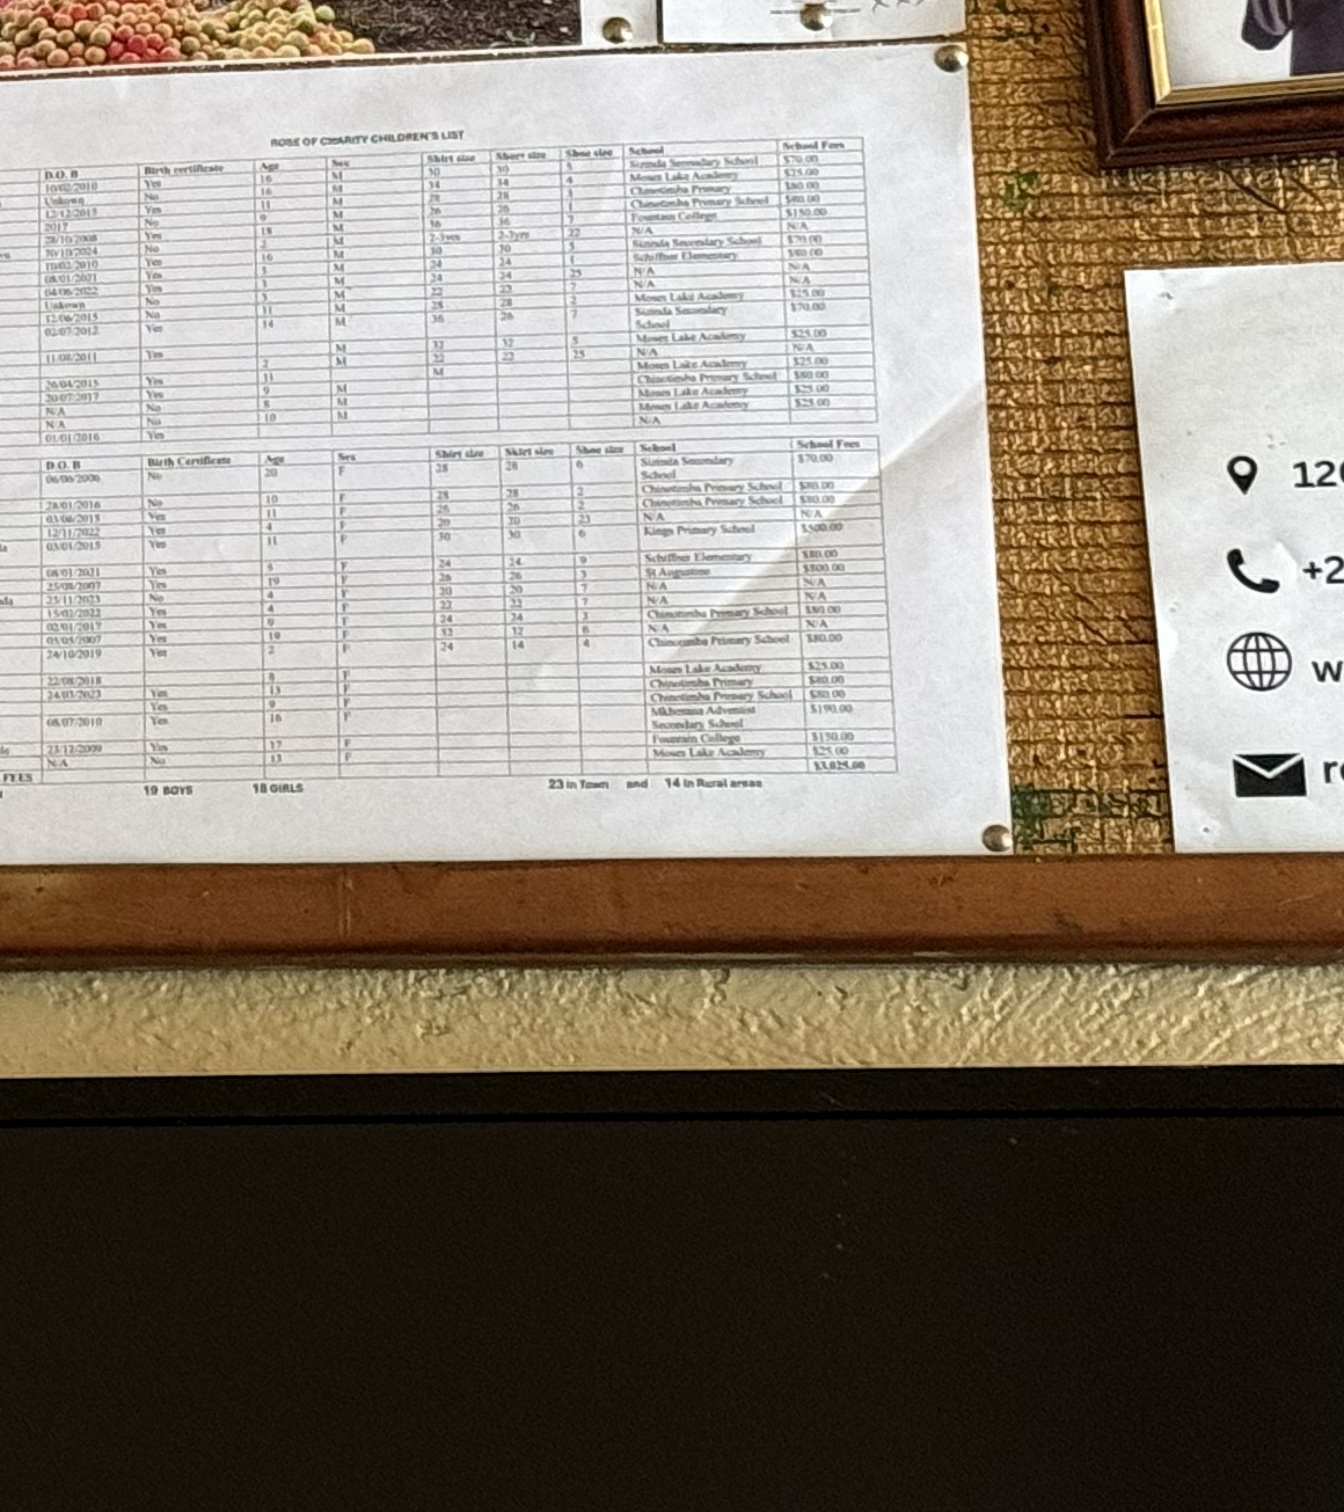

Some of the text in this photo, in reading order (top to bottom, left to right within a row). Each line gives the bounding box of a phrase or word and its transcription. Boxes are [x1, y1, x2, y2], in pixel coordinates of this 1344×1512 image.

[270, 130, 465, 148] ROSE OF CHARITY CHILDREN'S LIST
[628, 145, 664, 156] School
[782, 140, 845, 151] School Fees
[427, 153, 453, 163] Shirt
[565, 148, 591, 158] Shoe
[724, 156, 758, 166] School
[144, 163, 224, 176] Birth certificate
[727, 236, 762, 247] School
[640, 443, 676, 453] School
[797, 439, 860, 450] School Fees
[148, 457, 174, 467] Birth
[1292, 460, 1344, 487] 12
[747, 481, 783, 492] School
[748, 495, 783, 505] School
[720, 524, 755, 534] School
[685, 663, 762, 674] Lake Academy
[707, 718, 744, 729] School
[270, 783, 304, 793] GIRLS
[548, 778, 563, 789] 23
[566, 779, 577, 789] in
[626, 779, 649, 789] and
[665, 777, 762, 789] 14 in Rural areas
[143, 785, 193, 795] 19 BOYS
